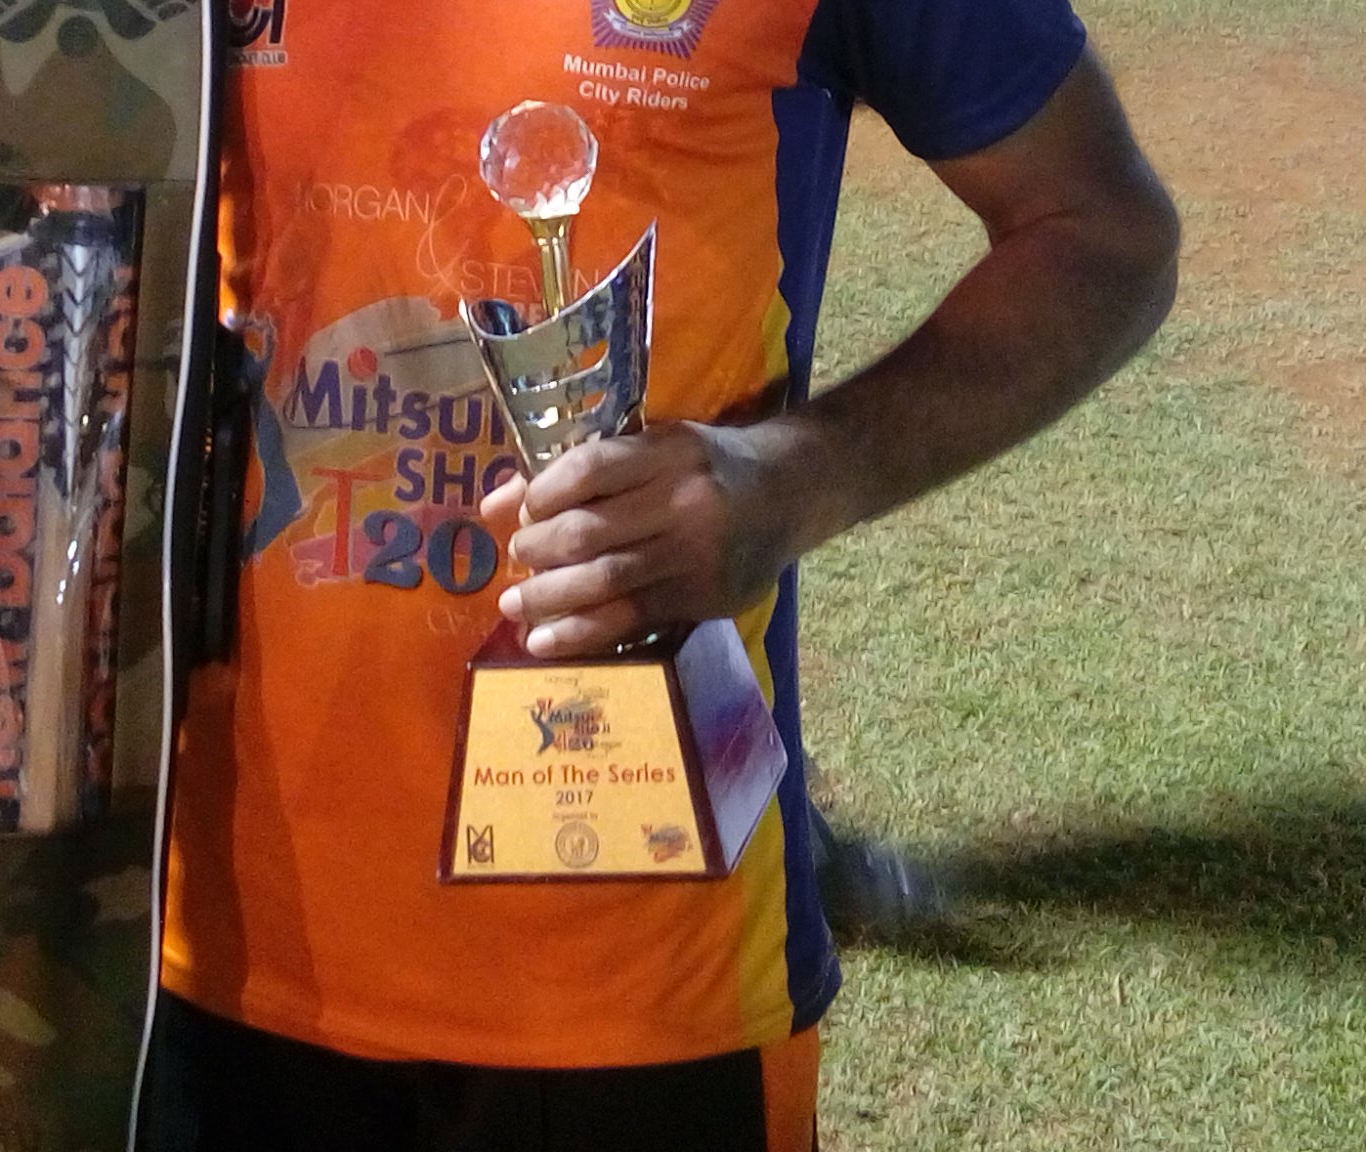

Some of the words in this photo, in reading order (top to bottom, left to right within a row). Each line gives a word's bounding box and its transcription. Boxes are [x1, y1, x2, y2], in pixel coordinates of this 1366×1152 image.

[563, 54, 646, 84] Mumbai
[652, 67, 711, 91] Police
[578, 80, 621, 107] City
[626, 88, 689, 111] Riders
[394, 448, 519, 507] SHO
[310, 466, 499, 595] T20
[473, 765, 524, 786] Man
[532, 764, 553, 785] of
[560, 763, 600, 785] The
[607, 762, 676, 784] Series
[555, 790, 594, 806] 2017
